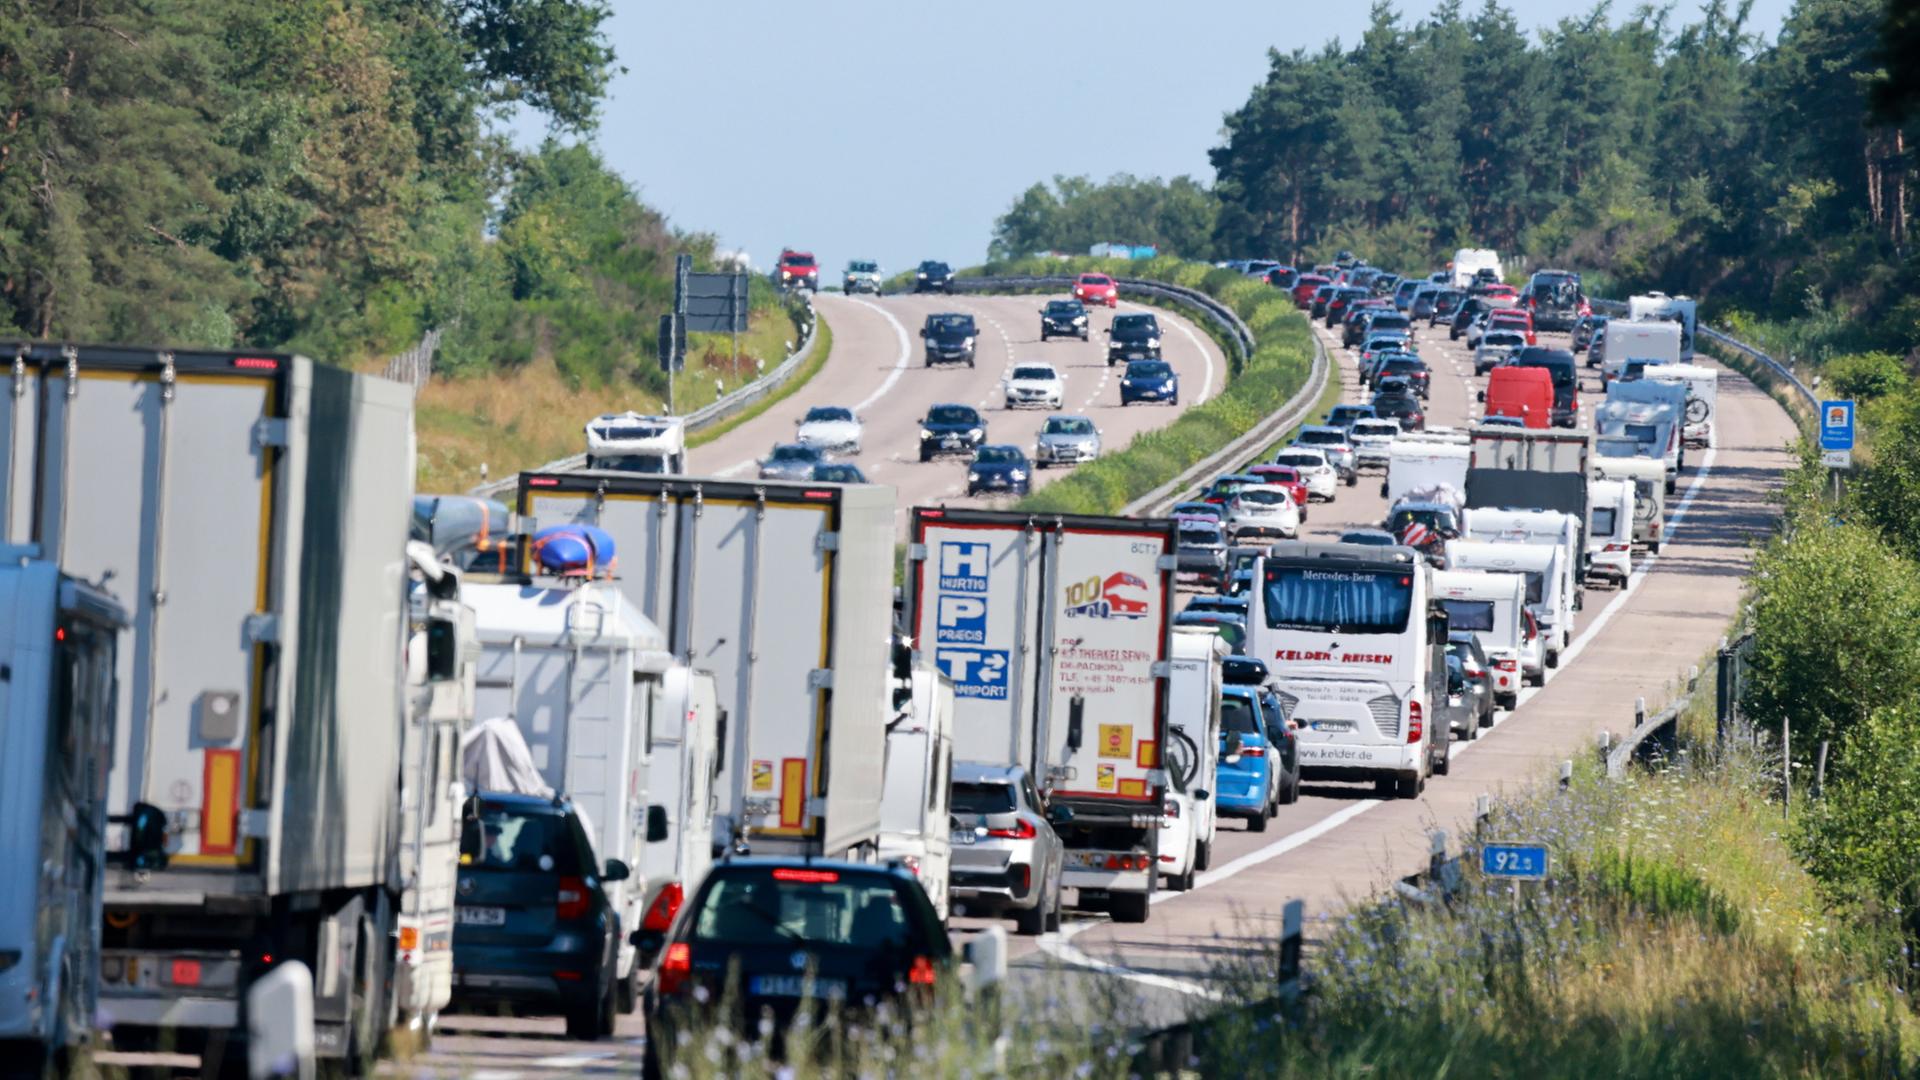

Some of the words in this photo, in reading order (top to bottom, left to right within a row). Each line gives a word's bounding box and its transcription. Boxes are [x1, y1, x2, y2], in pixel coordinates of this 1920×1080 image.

[942, 545, 988, 576] H
[1303, 570, 1377, 582] Mercedes-Benz
[941, 578, 986, 590] HURTIG
[1065, 575, 1101, 606] 100
[941, 598, 985, 627] P
[1275, 650, 1331, 661] KELDER
[1341, 653, 1393, 664] REISEN
[939, 651, 981, 681] T
[954, 684, 1007, 697] ANSPORT
[1300, 749, 1373, 761] ww.kelder.de
